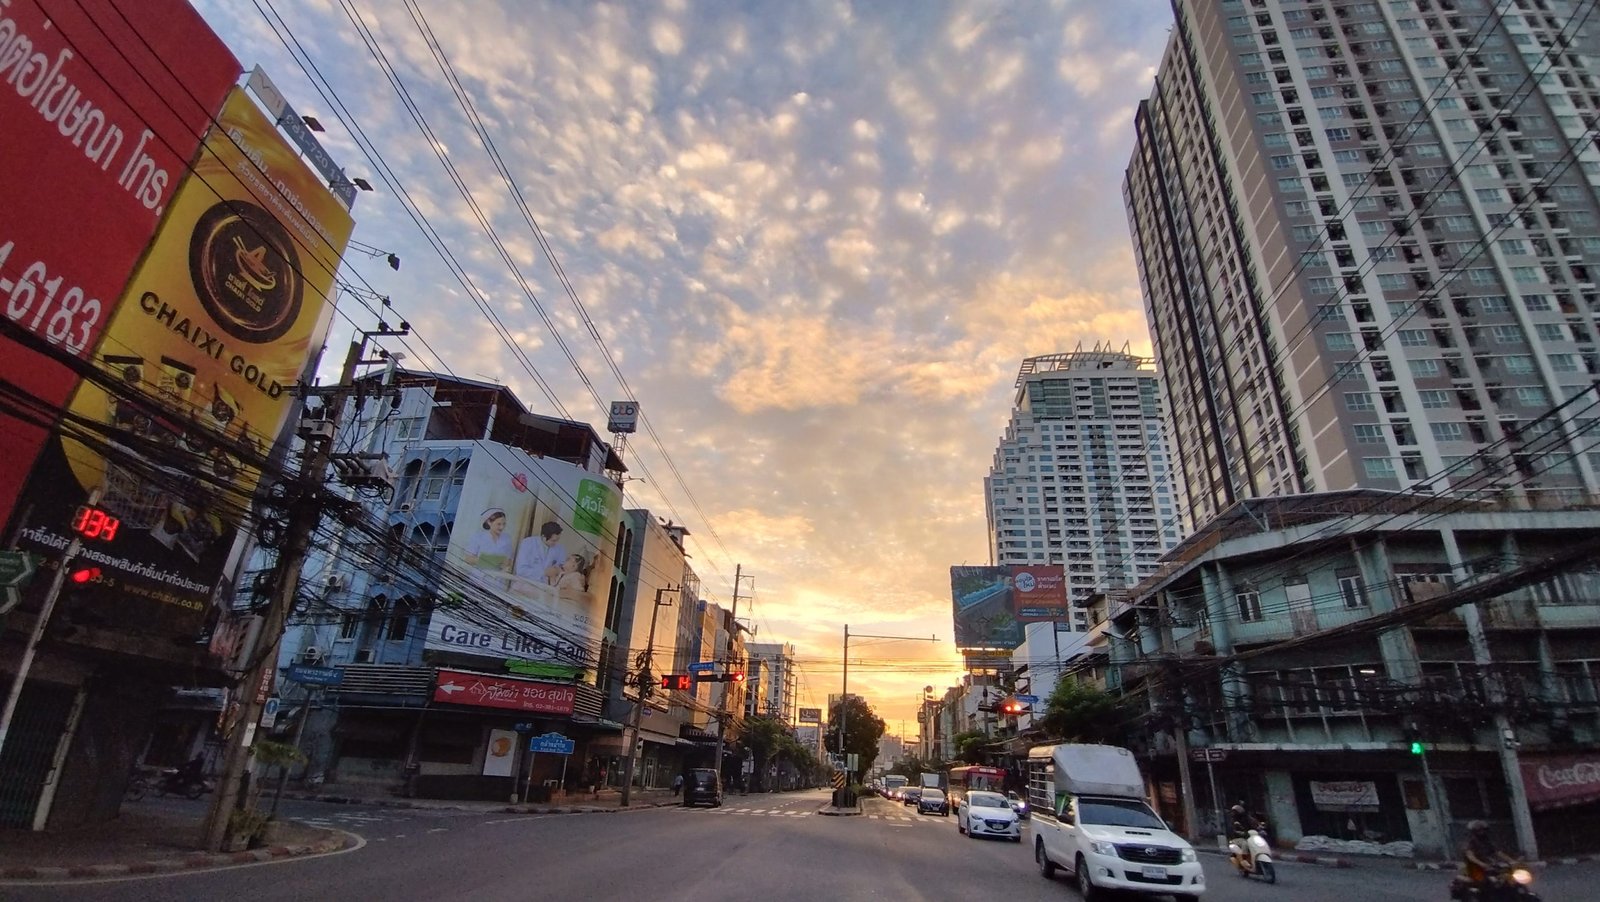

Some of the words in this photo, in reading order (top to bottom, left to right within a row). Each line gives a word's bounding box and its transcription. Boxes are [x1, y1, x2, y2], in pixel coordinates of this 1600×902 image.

[118, 129, 168, 216] โทร.
[140, 290, 223, 360] CHAIXI
[229, 354, 285, 401] GOLD
[441, 624, 492, 647] Care
[502, 632, 543, 656] Like
[523, 687, 546, 699] ซอย
